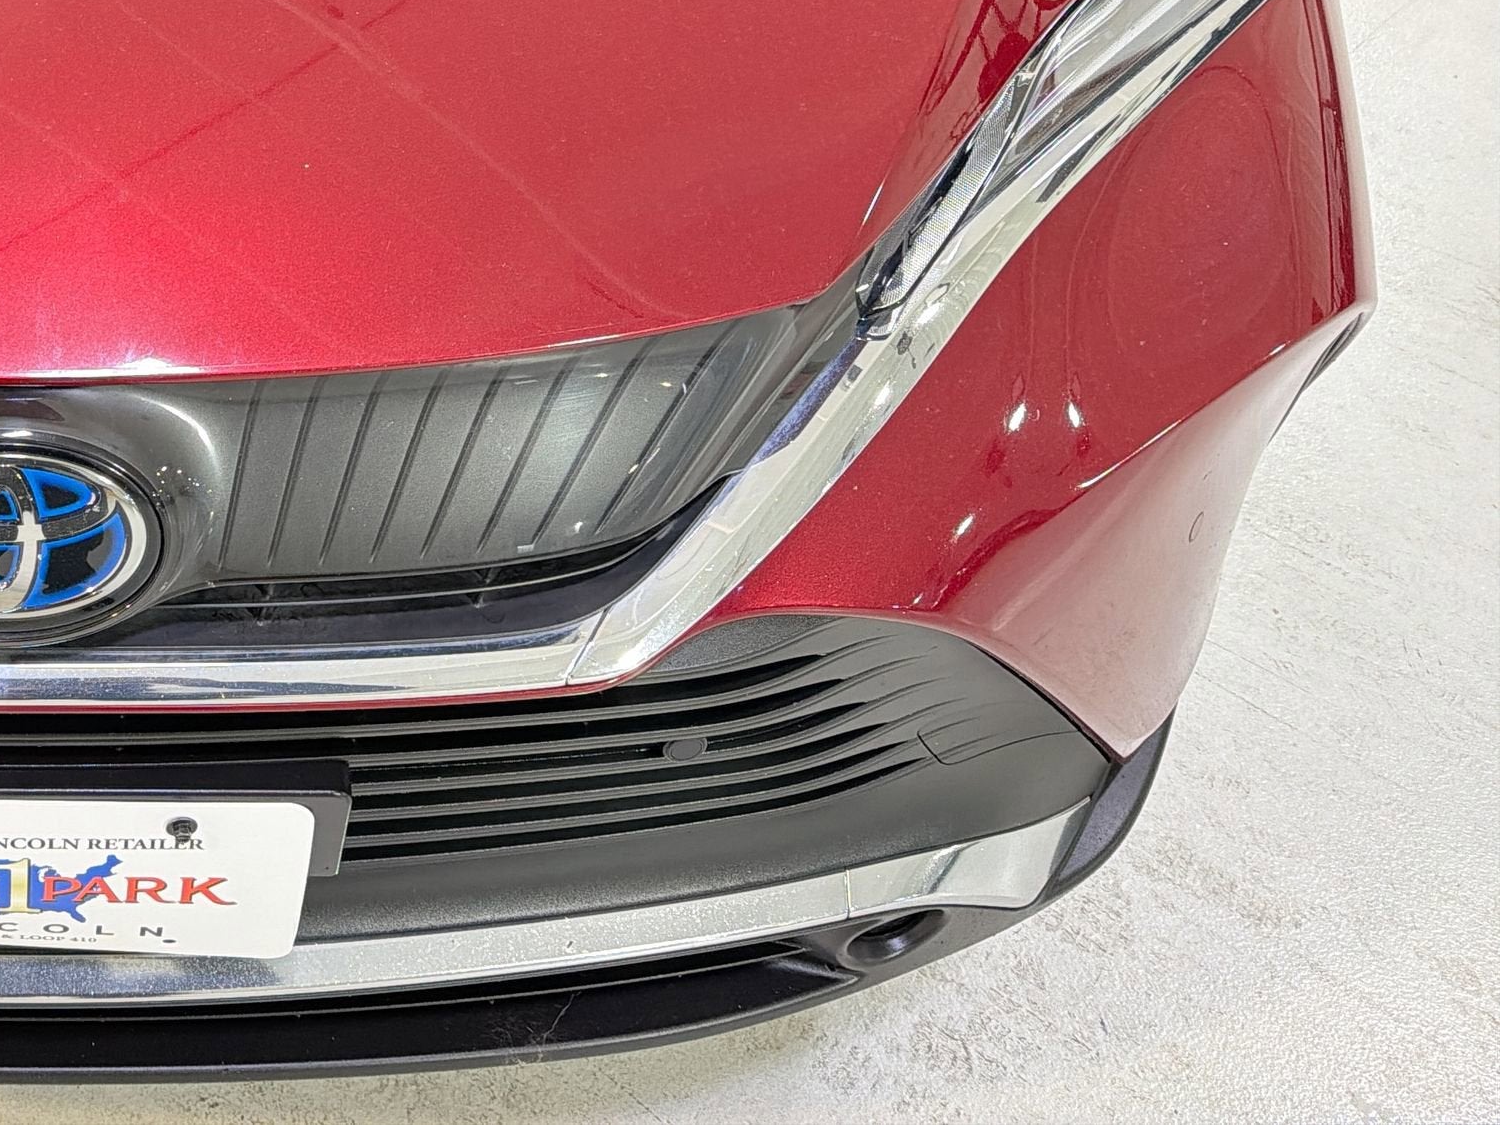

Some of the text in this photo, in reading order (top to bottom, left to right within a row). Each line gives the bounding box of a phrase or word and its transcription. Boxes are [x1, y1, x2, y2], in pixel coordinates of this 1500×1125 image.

[86, 837, 206, 851] RETAILER
[42, 876, 238, 906] PARK
[20, 934, 66, 942] LOOP
[71, 936, 98, 944] 410
